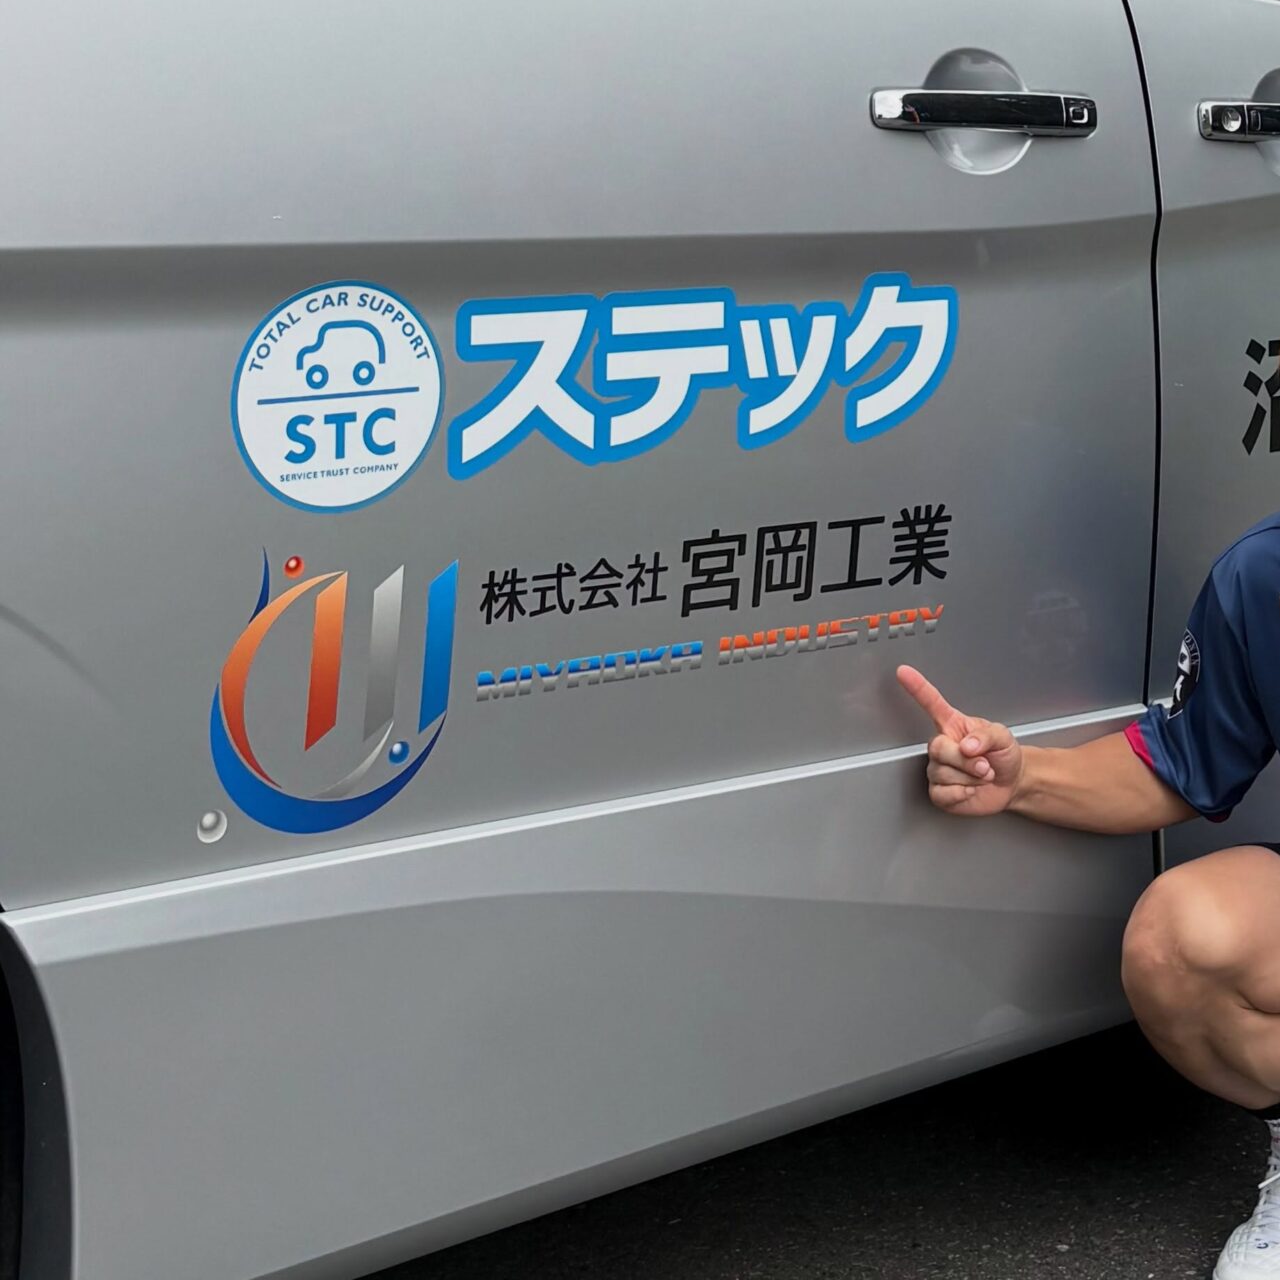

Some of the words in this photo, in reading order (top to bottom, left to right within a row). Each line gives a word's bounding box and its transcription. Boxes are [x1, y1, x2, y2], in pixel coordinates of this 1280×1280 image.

[248, 312, 302, 372] TOTAL
[305, 291, 350, 314] CAR
[356, 292, 431, 360] SUPPORT
[460, 285, 951, 465] ステック
[284, 407, 396, 465] STC
[279, 472, 318, 483] SERVICE
[320, 467, 350, 478] TRUST
[353, 463, 399, 475] COMPANY
[718, 604, 945, 666] INDUSTRY
